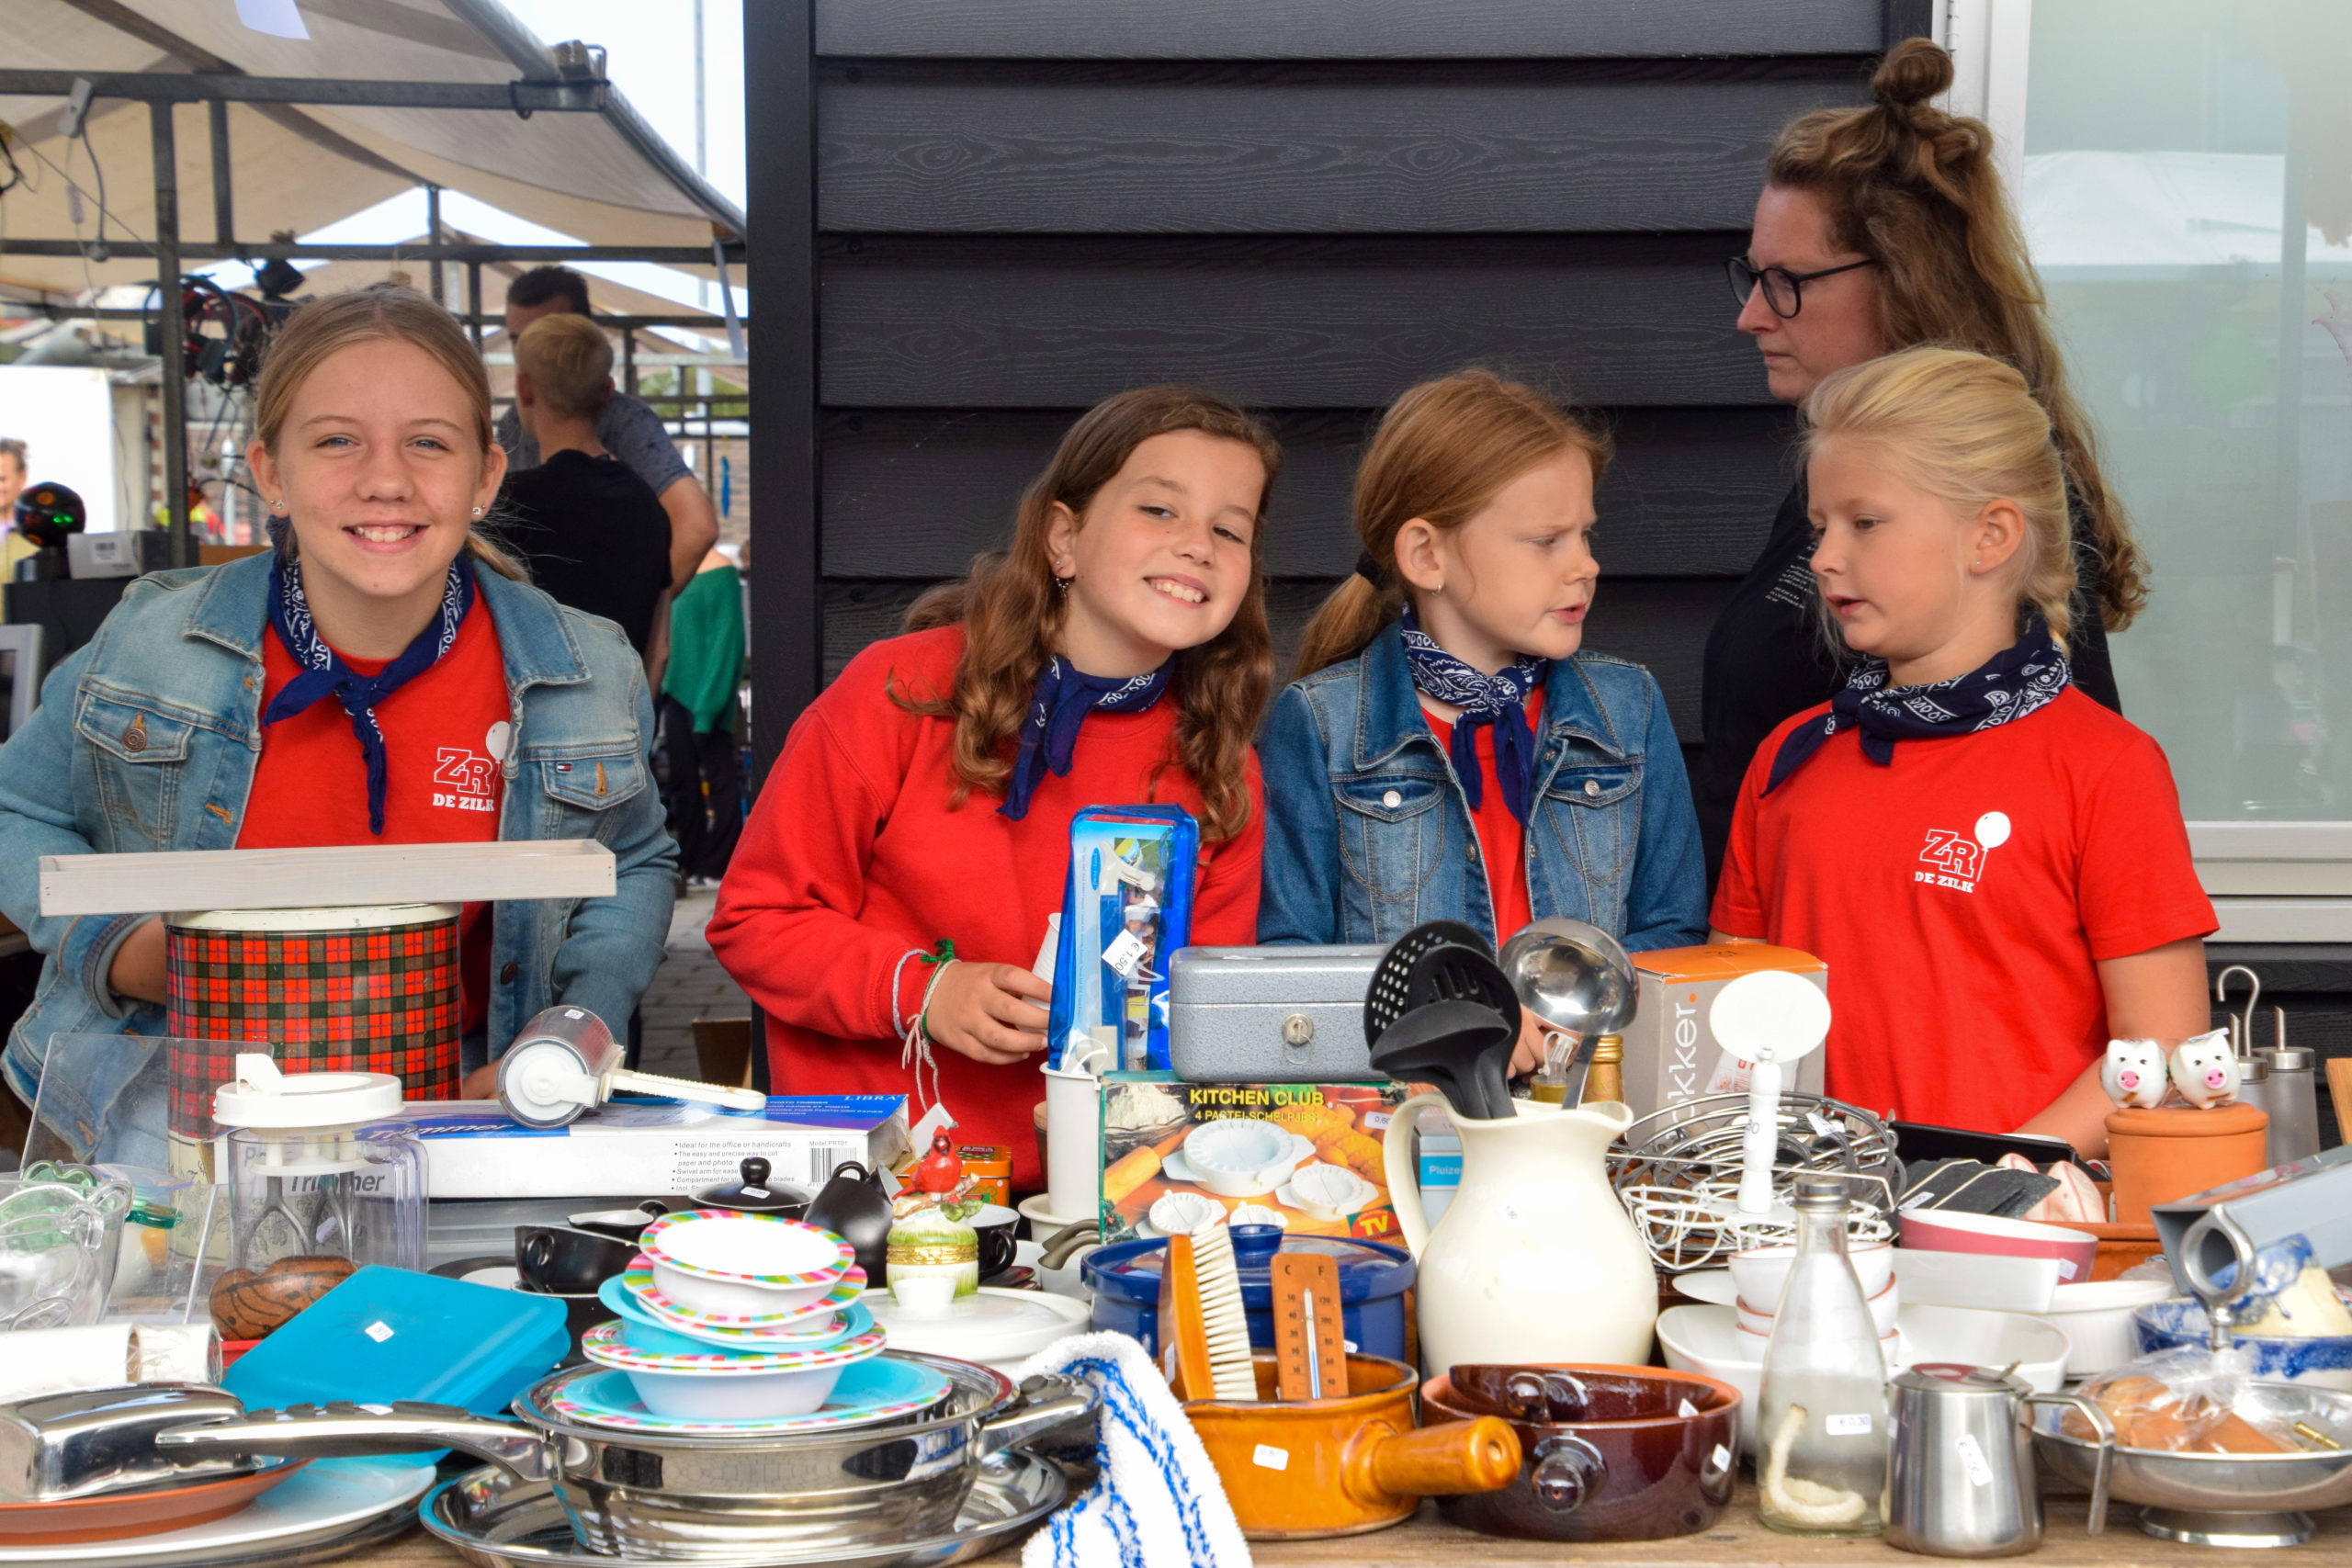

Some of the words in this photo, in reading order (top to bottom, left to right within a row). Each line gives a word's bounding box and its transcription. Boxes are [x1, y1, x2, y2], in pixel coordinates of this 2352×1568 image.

[433, 746, 493, 795] ZR
[432, 793, 456, 808] DE
[1918, 829, 1979, 879] ZR
[1914, 870, 1936, 885] DE
[1936, 874, 1975, 894] ZILK
[1189, 1088, 1270, 1106] KITCHEN
[1274, 1090, 1324, 1107] CLUB
[1194, 1109, 1202, 1121] 4
[1359, 1214, 1388, 1237] TV
[1284, 1264, 1292, 1276] C
[1317, 1265, 1325, 1276] F
